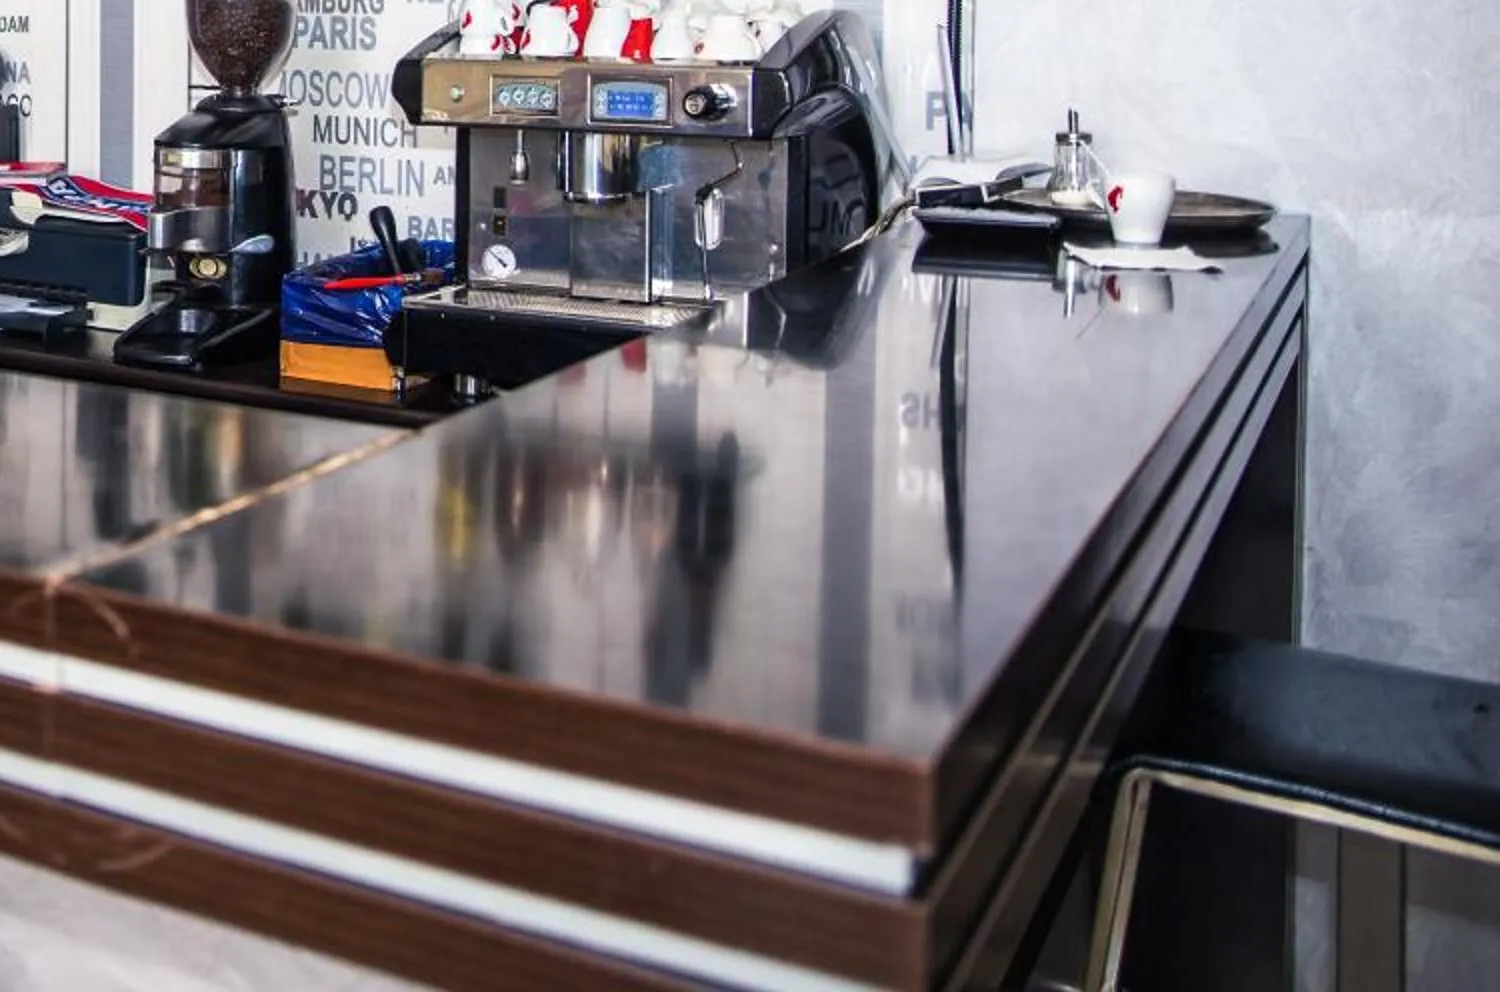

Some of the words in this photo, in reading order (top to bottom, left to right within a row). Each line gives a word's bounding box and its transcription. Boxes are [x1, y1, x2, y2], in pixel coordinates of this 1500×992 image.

[292, 16, 377, 50] PARIS
[313, 116, 418, 148] MUNICH
[320, 154, 424, 197] BERLIN
